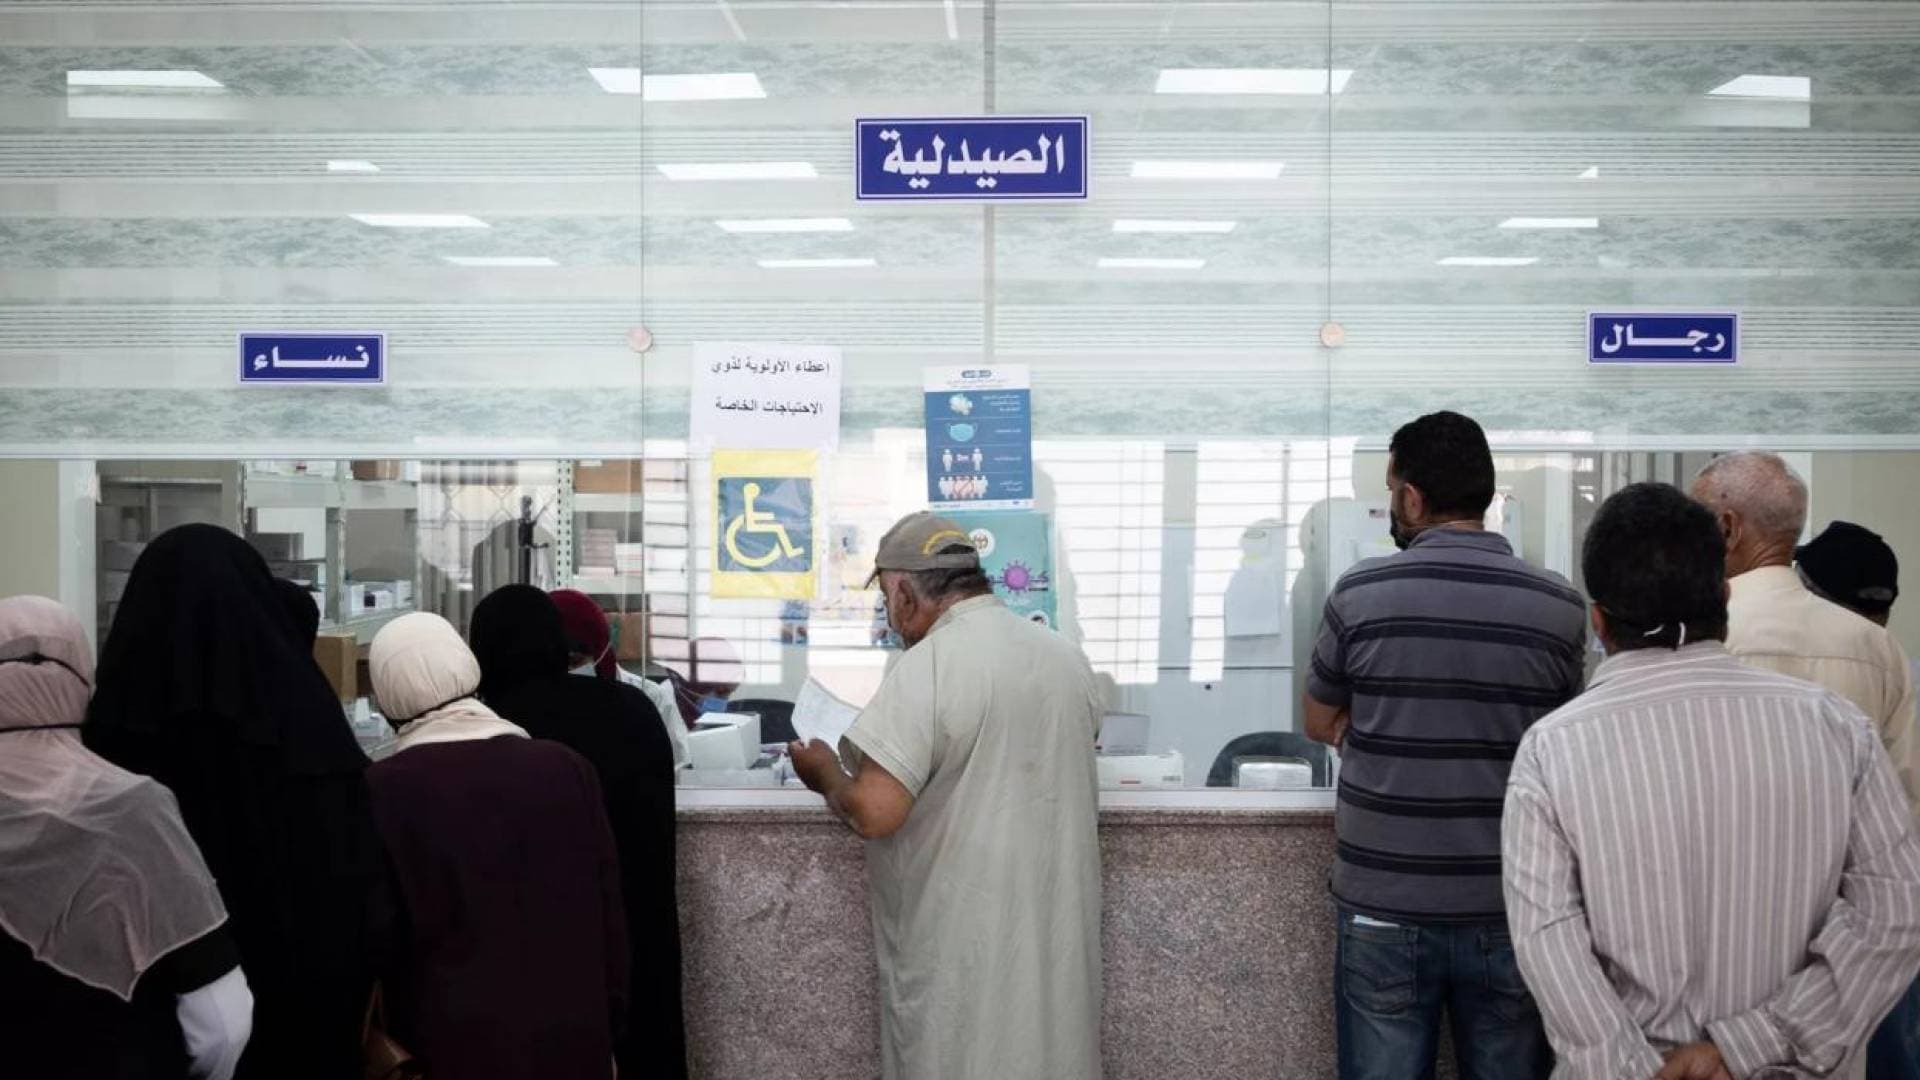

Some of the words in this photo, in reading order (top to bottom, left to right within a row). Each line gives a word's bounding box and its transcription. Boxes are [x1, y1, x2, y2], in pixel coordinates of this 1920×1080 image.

[879, 129, 1065, 189] الصيدلية
[1601, 323, 1726, 353] رجال
[253, 344, 370, 371] نساء
